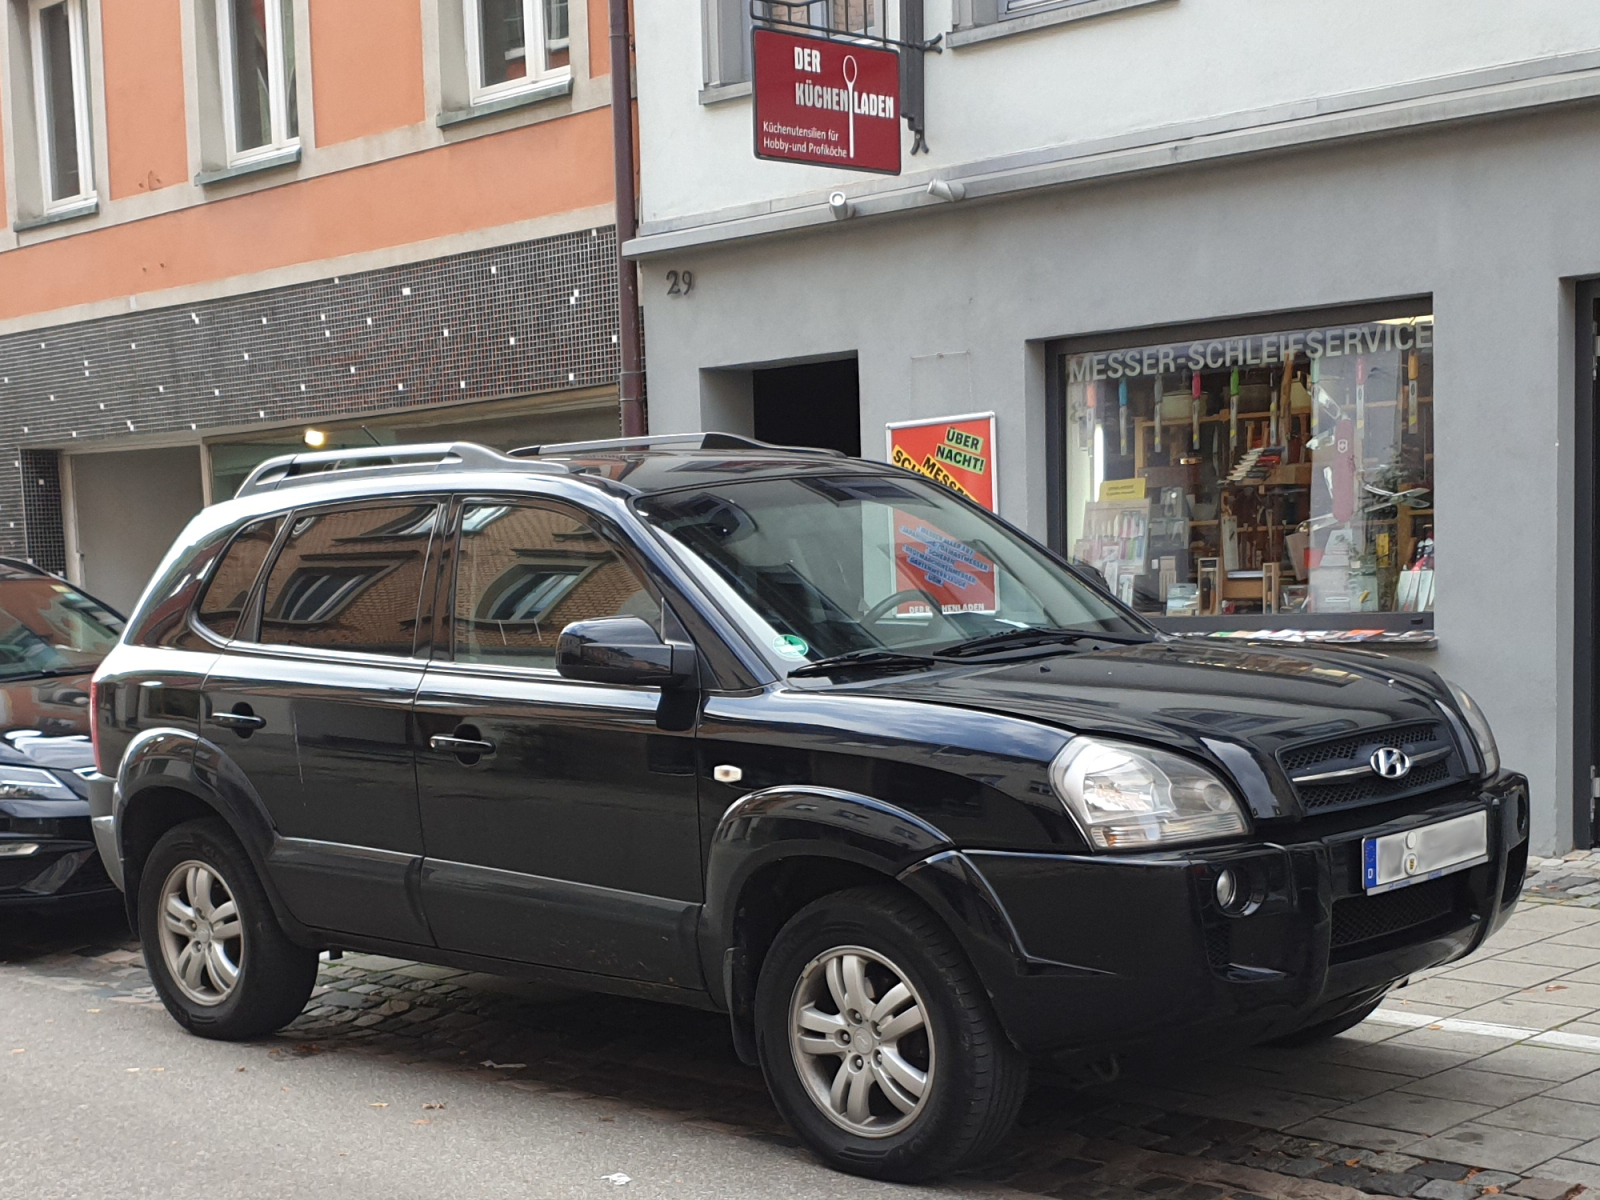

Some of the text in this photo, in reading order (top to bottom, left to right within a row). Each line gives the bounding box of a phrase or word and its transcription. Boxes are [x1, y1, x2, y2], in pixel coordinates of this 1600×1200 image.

[794, 47, 821, 73] DER
[763, 121, 839, 141] Küchenutensilien für
[808, 142, 847, 158] Profiköche
[666, 270, 692, 296] 29
[1069, 321, 1433, 383] MESSER-SCHLEIFSERVICE
[946, 427, 980, 451] ÜBER
[936, 445, 984, 472] NACHT!
[922, 456, 974, 499] MESS
